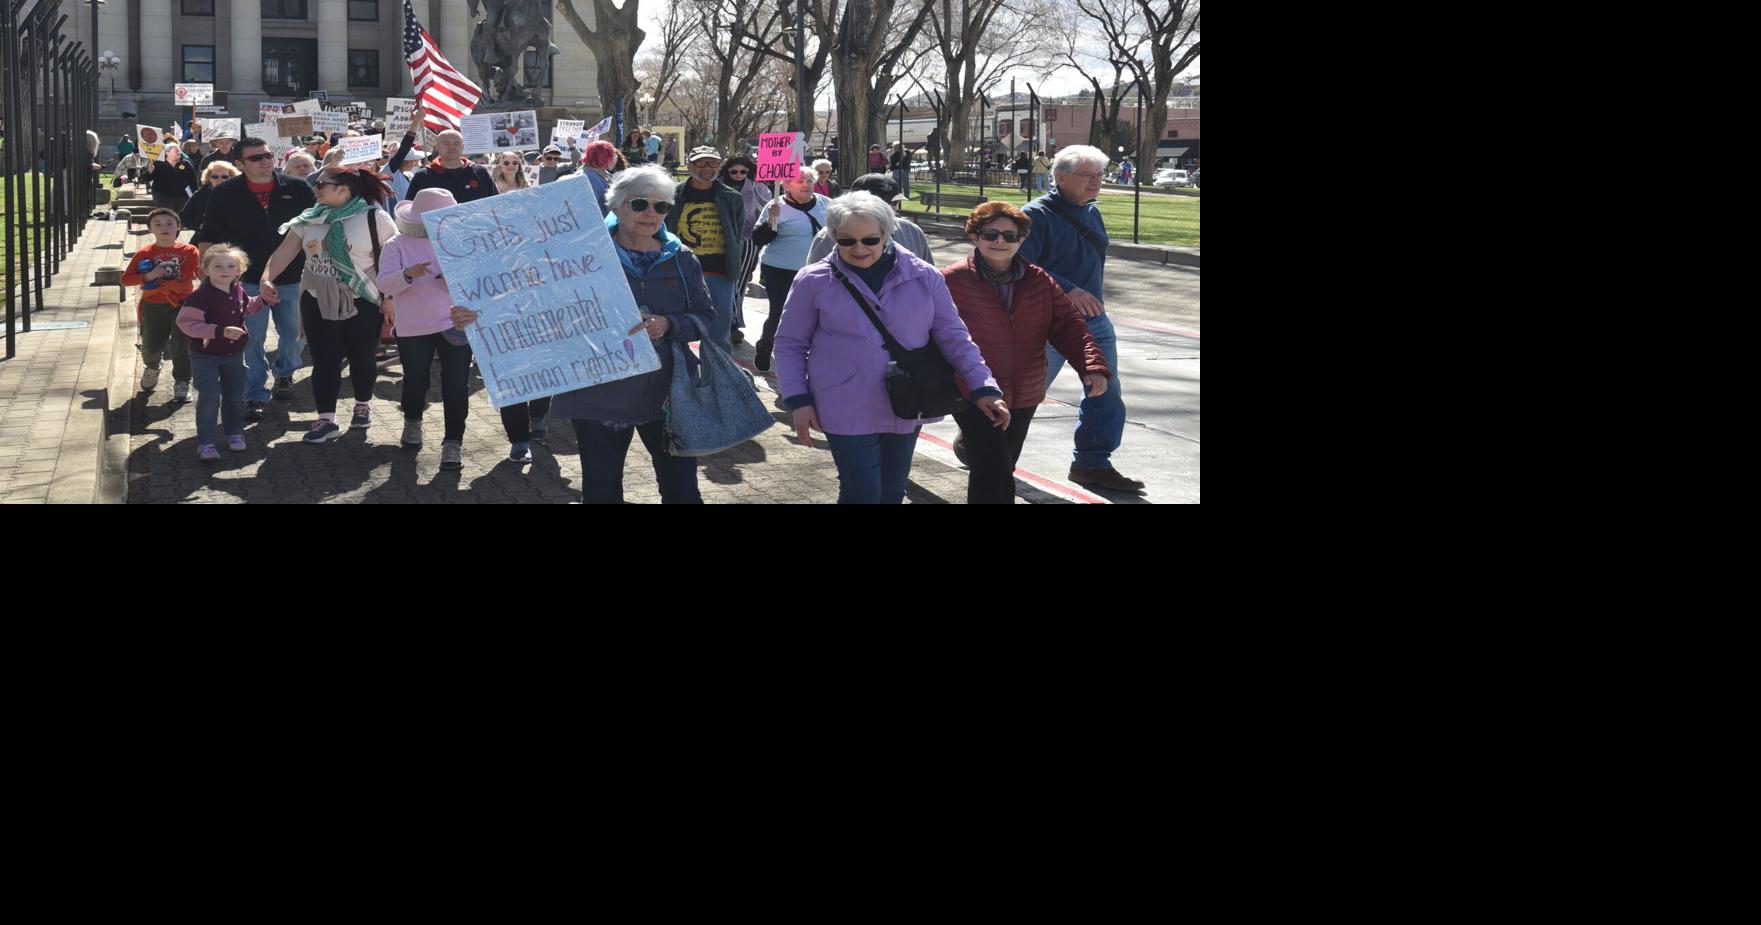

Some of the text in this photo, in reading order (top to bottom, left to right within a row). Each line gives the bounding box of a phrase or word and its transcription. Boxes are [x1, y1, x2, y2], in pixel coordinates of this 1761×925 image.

[760, 136, 791, 149] MOTHER
[772, 149, 783, 157] BY
[759, 163, 796, 179] CHOICE
[437, 200, 580, 257] Girls just
[458, 250, 602, 302] wanna have
[475, 286, 609, 357] fundamental
[490, 339, 640, 399] human rights!
